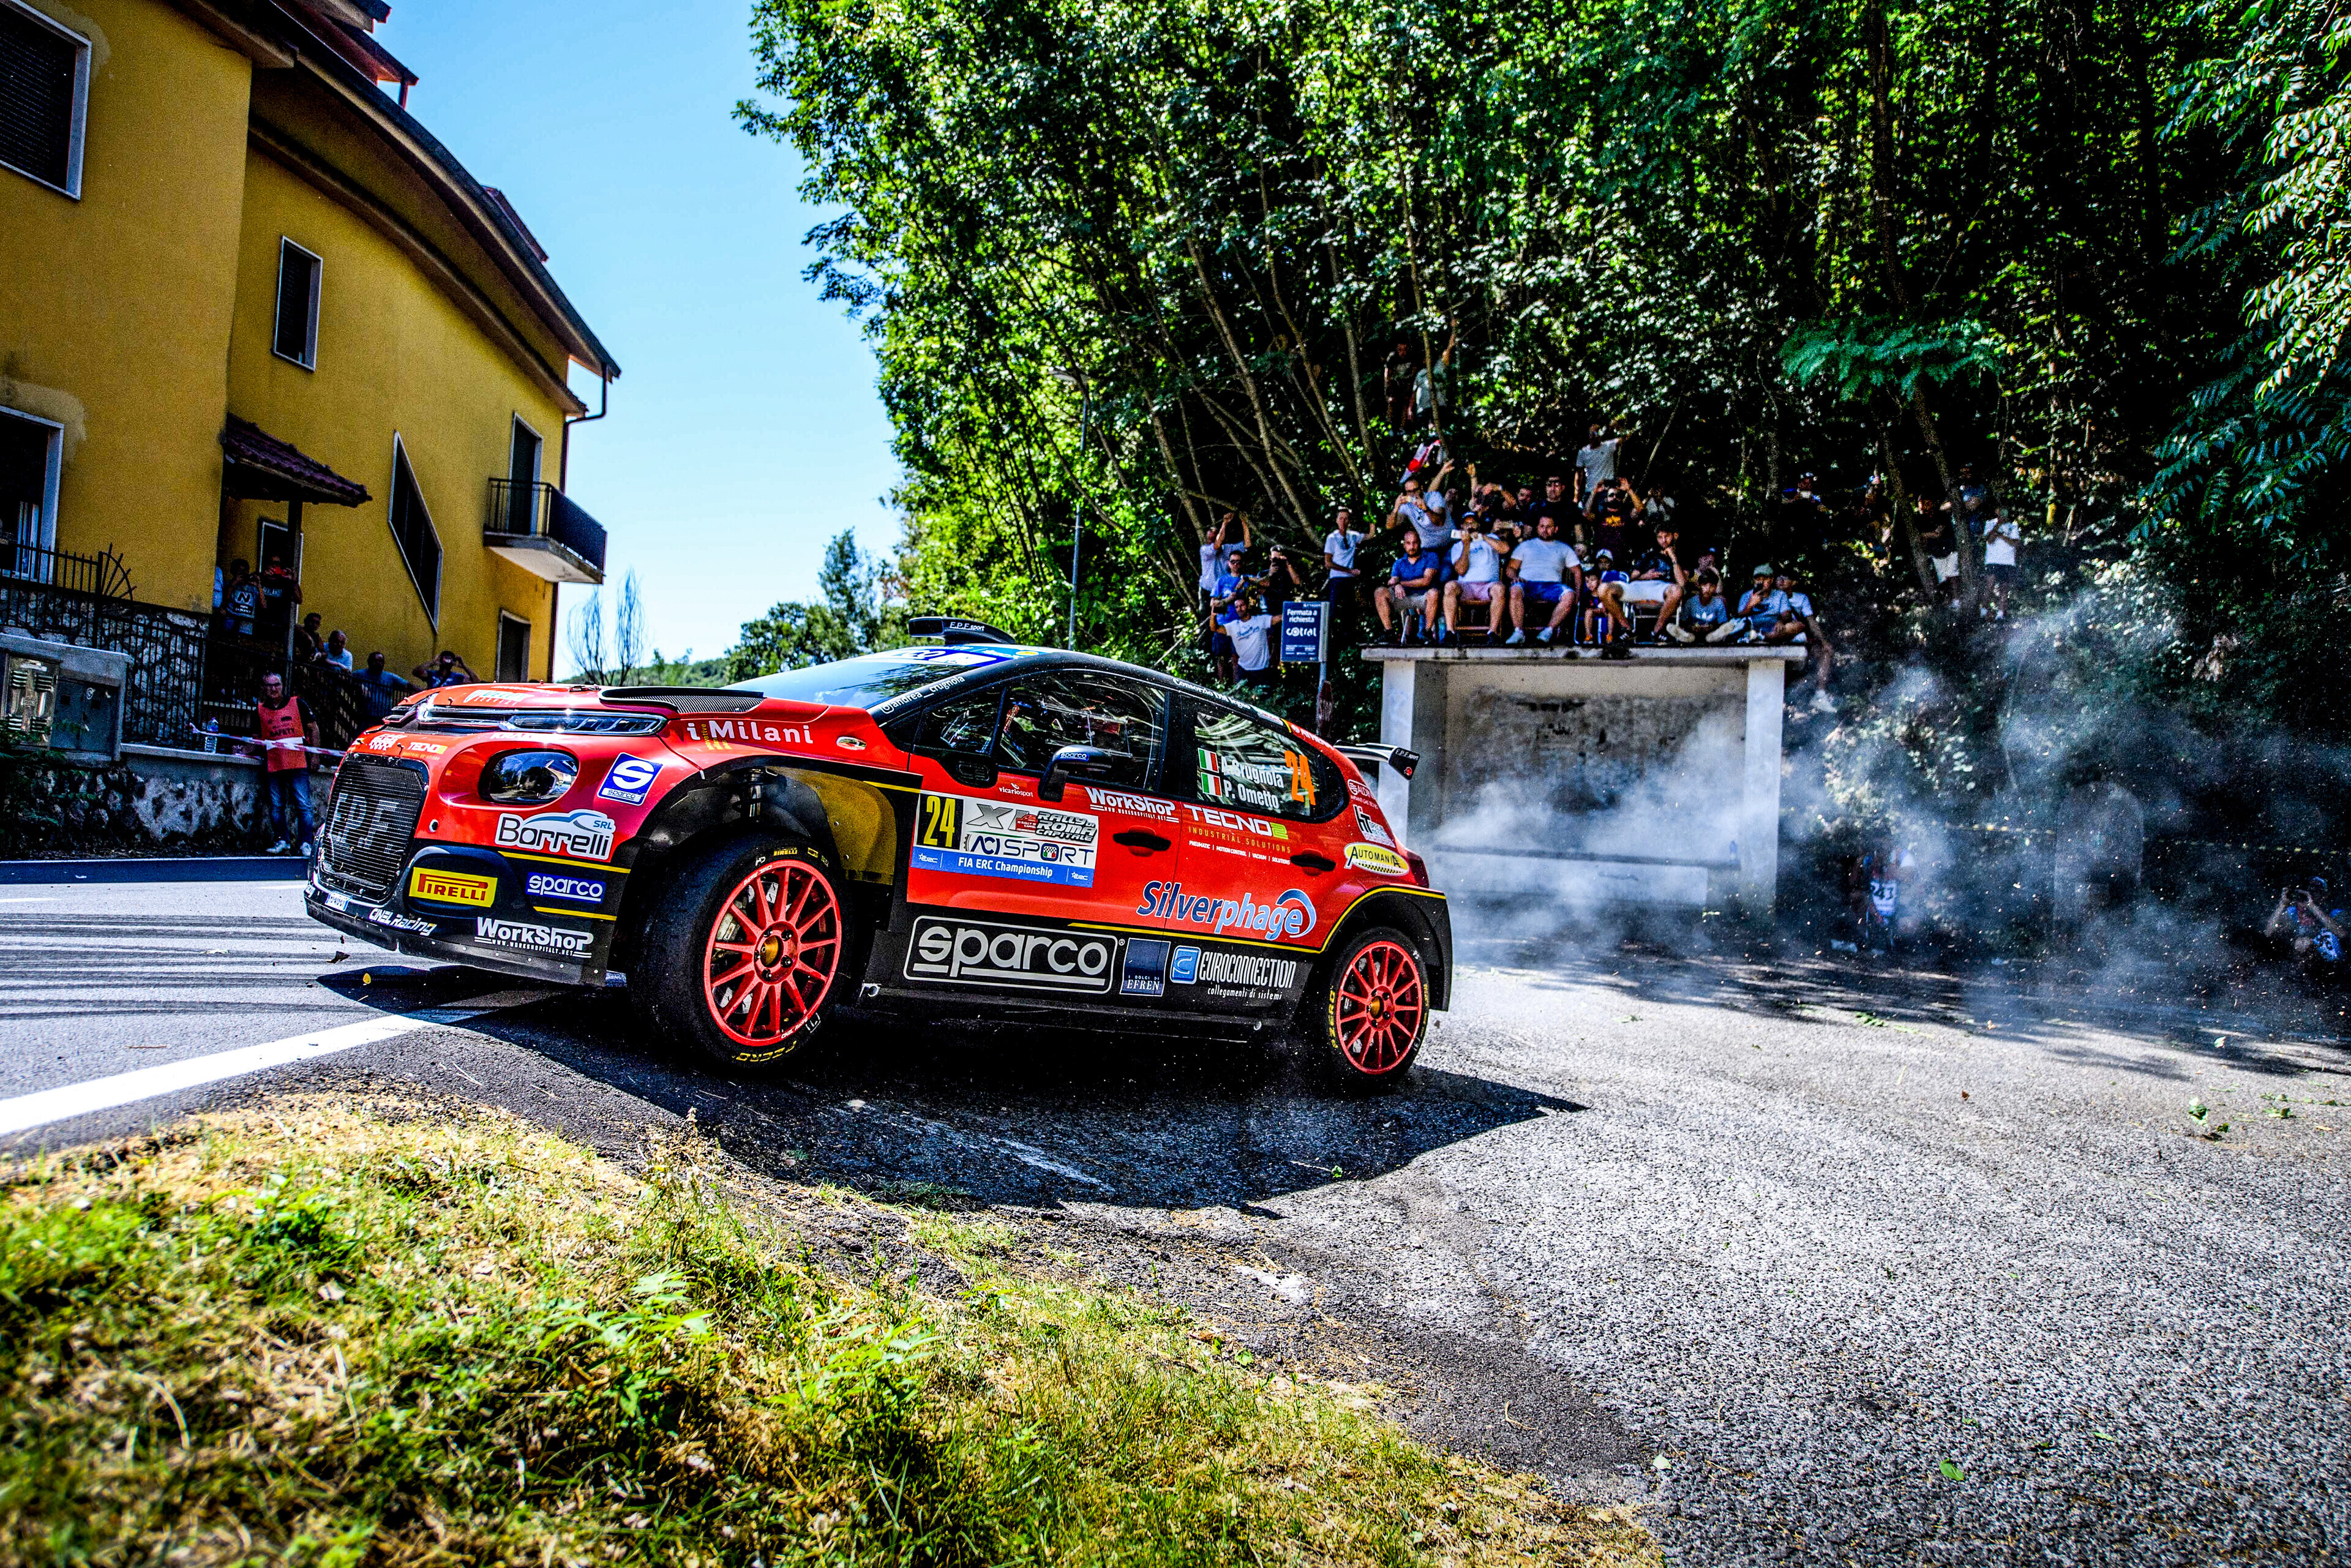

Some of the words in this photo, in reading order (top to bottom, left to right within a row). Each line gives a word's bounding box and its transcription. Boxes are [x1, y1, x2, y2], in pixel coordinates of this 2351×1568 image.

[1286, 627, 1316, 636] cotral
[709, 721, 813, 744] Milani
[1284, 750, 1316, 805] 24
[608, 789, 636, 799] sparco
[1224, 779, 1235, 799] P.
[1237, 784, 1280, 809] Ometto
[593, 820, 613, 830] SRL
[923, 795, 956, 847] 24
[1037, 811, 1086, 826] RALLY
[1037, 821, 1097, 836] ROMA
[498, 817, 610, 856] Barrelli
[1035, 829, 1093, 842] CAPITALE
[1188, 826, 1241, 844] INDUSTRIAL
[1245, 838, 1291, 853] SOLUTIONS
[1004, 838, 1094, 865] SPORT
[958, 857, 973, 868] FIA
[976, 859, 992, 870] ERC
[996, 861, 1053, 877] Championship
[418, 874, 487, 901] PIRELLI
[529, 876, 602, 898] sparco
[369, 908, 394, 926] CINEL
[390, 914, 438, 936] Racing
[1136, 880, 1303, 940] Silverphage
[918, 926, 1108, 978] sparco
[1199, 951, 1297, 989] EUROCONNECTION
[1127, 980, 1160, 991] EFREN
[1207, 985, 1247, 998] collegamenti
[1249, 987, 1255, 999] di
[1258, 989, 1283, 1000] sistemi
